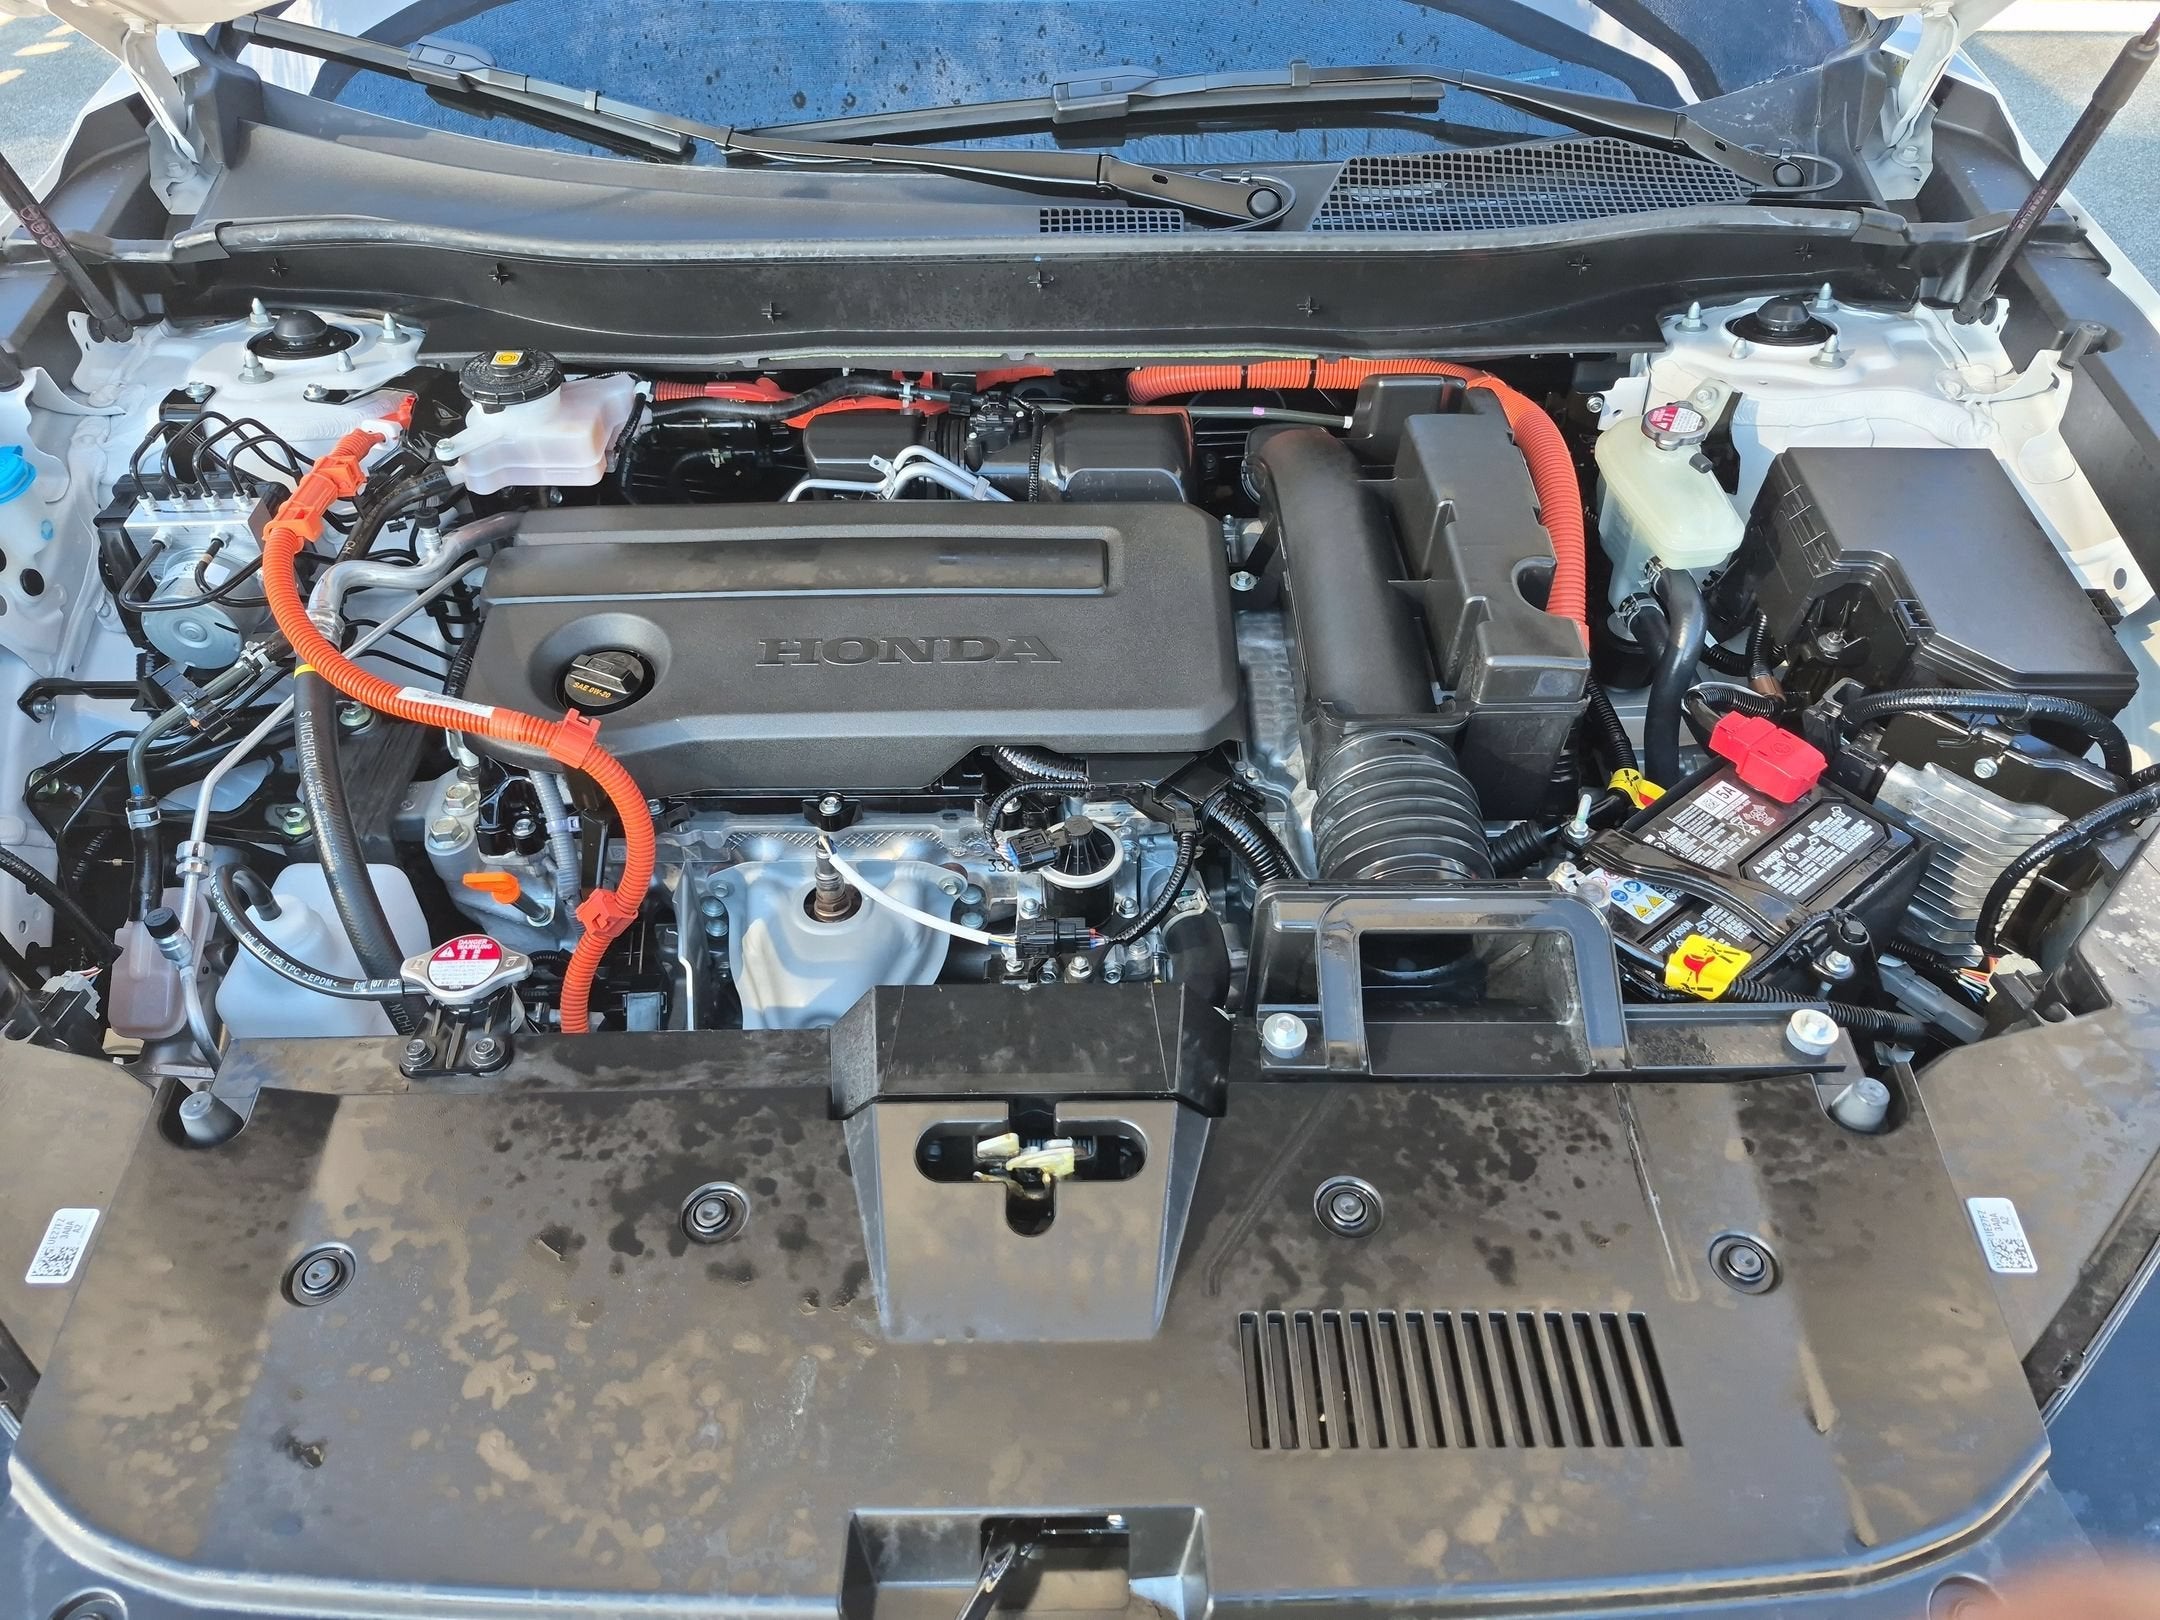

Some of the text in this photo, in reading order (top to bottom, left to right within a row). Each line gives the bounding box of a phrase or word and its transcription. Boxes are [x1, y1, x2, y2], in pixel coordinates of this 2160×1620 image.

[756, 636, 1062, 667] HONDA
[572, 681, 612, 699] SAE 0W-20
[1716, 784, 1737, 800] 5A
[284, 962, 301, 975] TPC
[303, 971, 339, 988] >EPDM<
